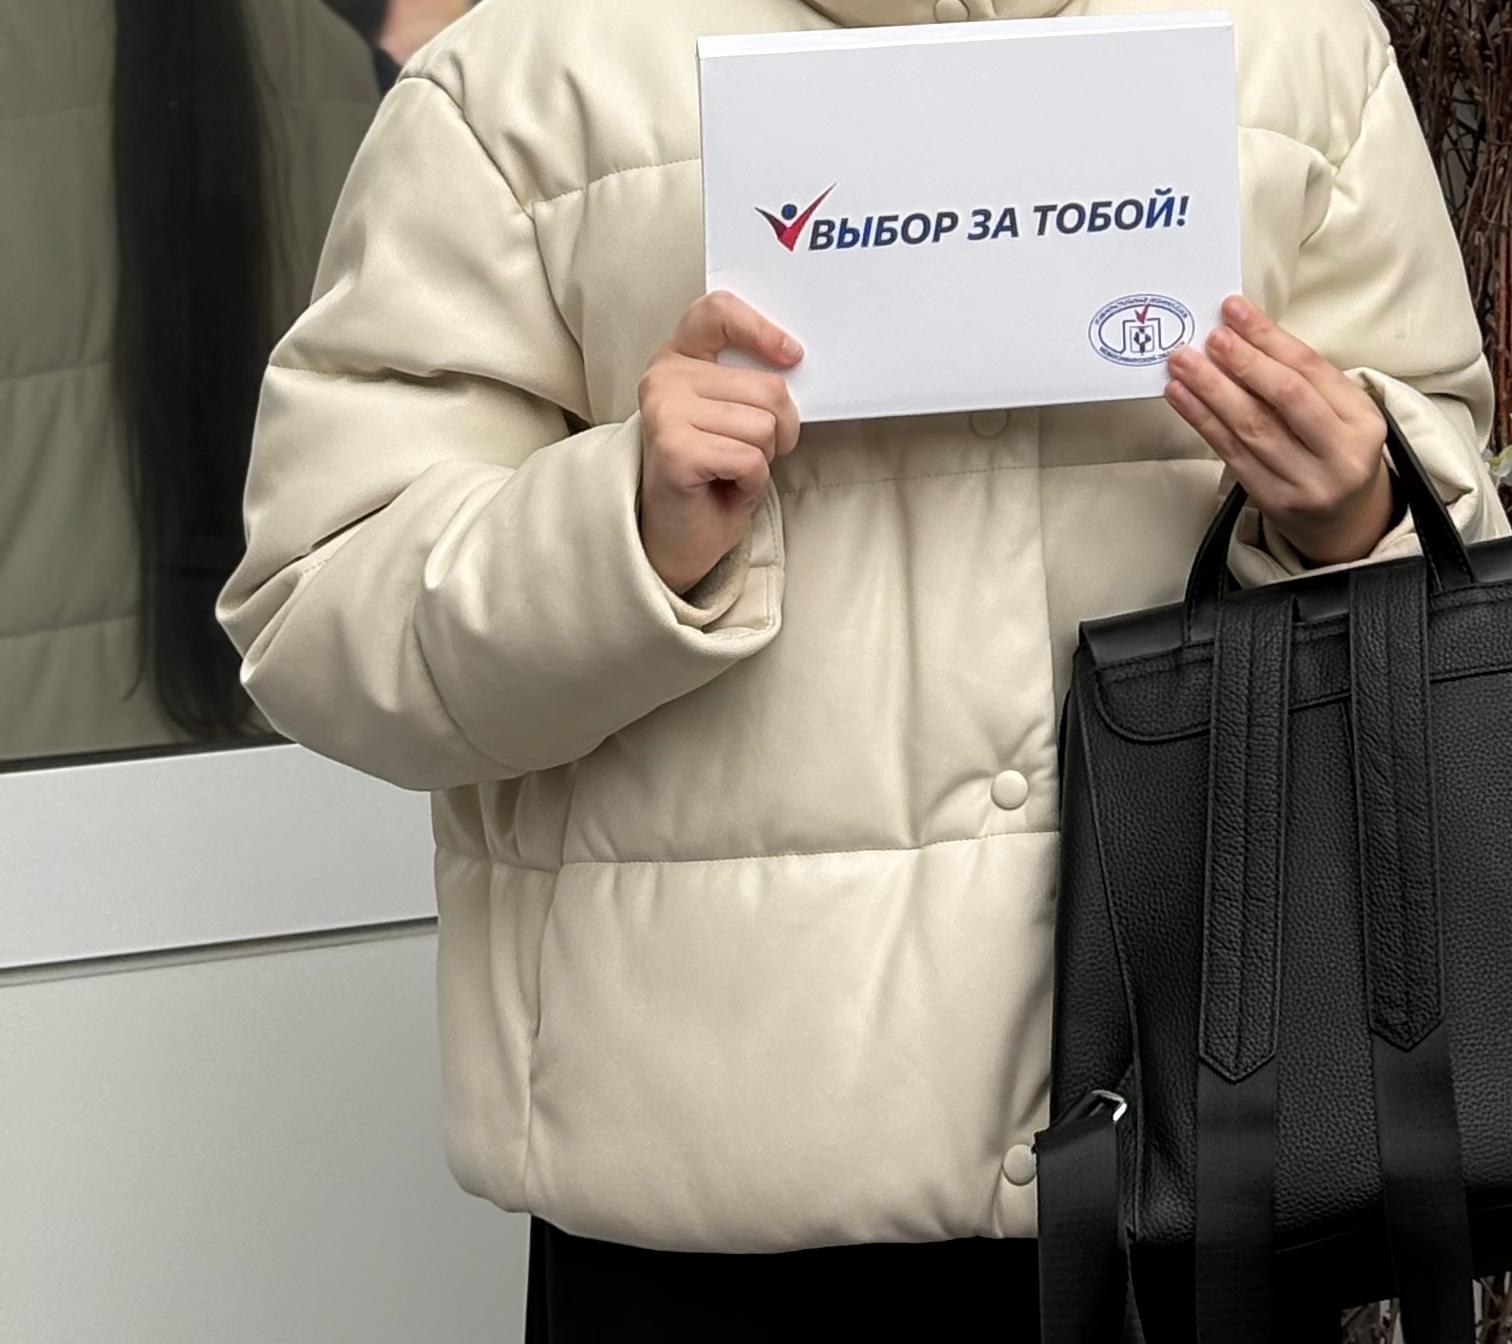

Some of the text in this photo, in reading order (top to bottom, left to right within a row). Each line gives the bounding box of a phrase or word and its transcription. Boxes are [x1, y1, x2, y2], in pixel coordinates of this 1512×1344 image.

[807, 186, 1190, 251] ВЫБОР ЗА ТОБОЙ!
